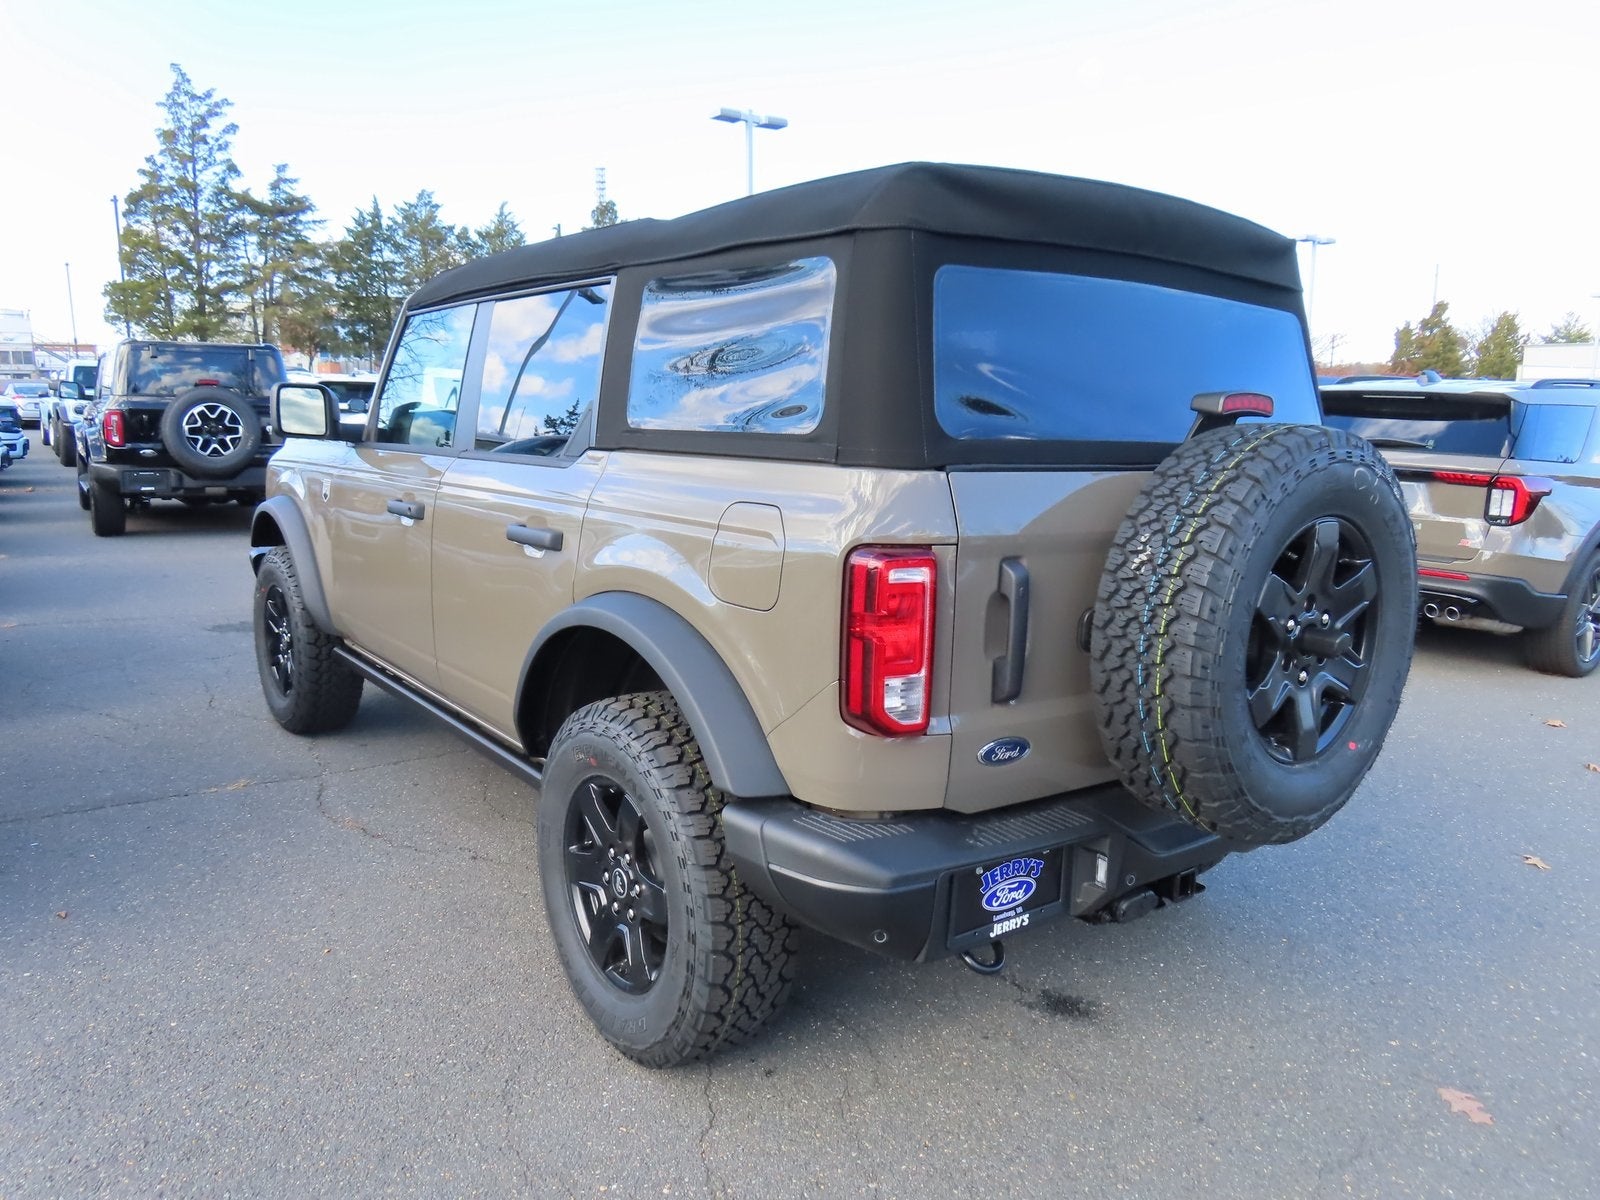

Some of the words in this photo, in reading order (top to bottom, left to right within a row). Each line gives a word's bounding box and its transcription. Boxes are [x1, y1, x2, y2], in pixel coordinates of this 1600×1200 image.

[991, 744, 1020, 761] Ford
[980, 858, 1044, 894] JERRY'S
[992, 882, 1027, 907] Ford
[989, 913, 1030, 938] JERRY'S
